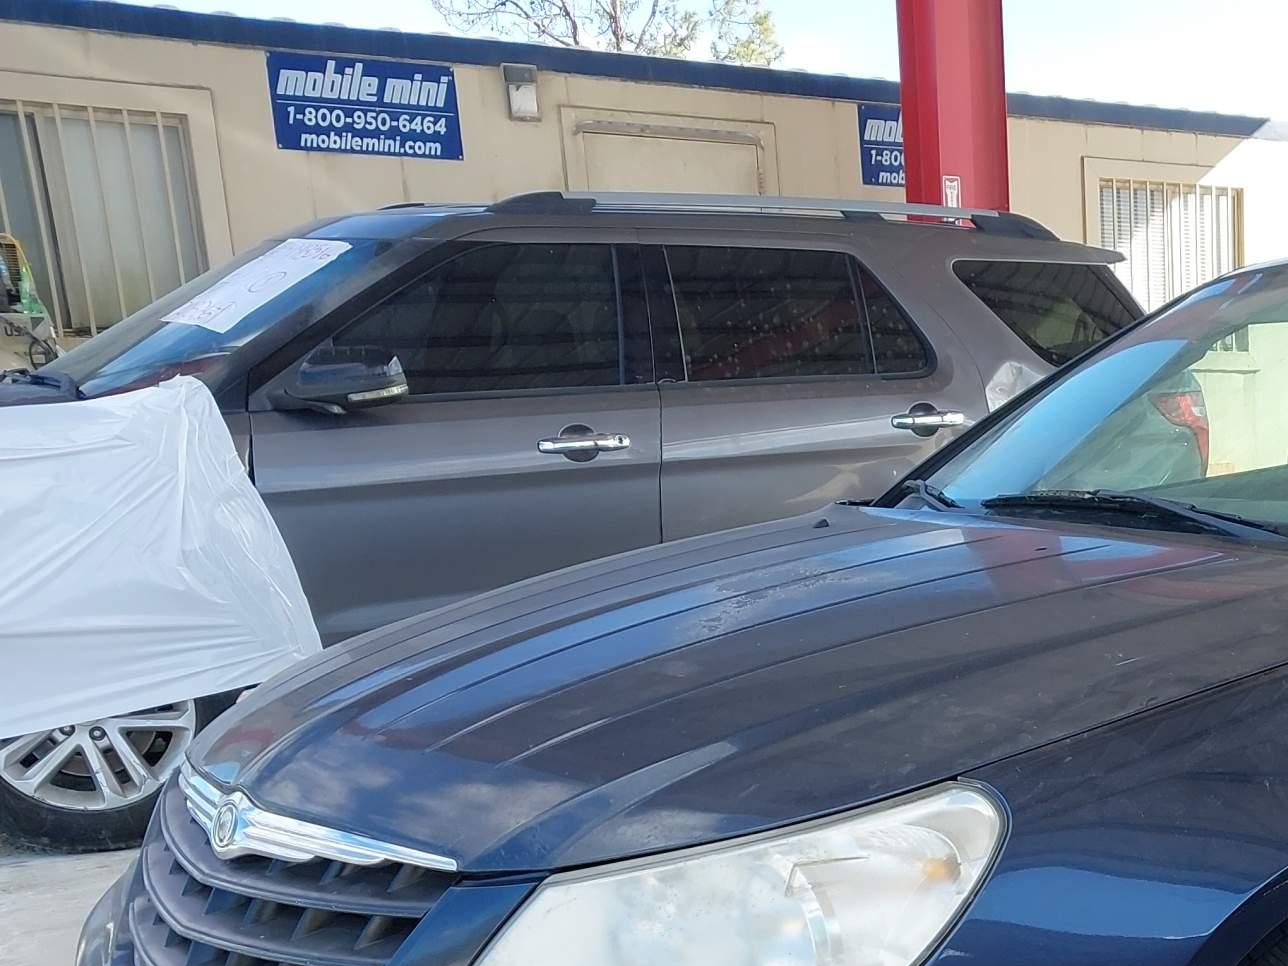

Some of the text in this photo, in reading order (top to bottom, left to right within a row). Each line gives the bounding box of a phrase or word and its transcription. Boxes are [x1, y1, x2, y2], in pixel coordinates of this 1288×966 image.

[276, 59, 450, 108] mobile mini
[286, 106, 447, 135] 1-800-950-6464
[300, 131, 442, 156] mobilemini.com
